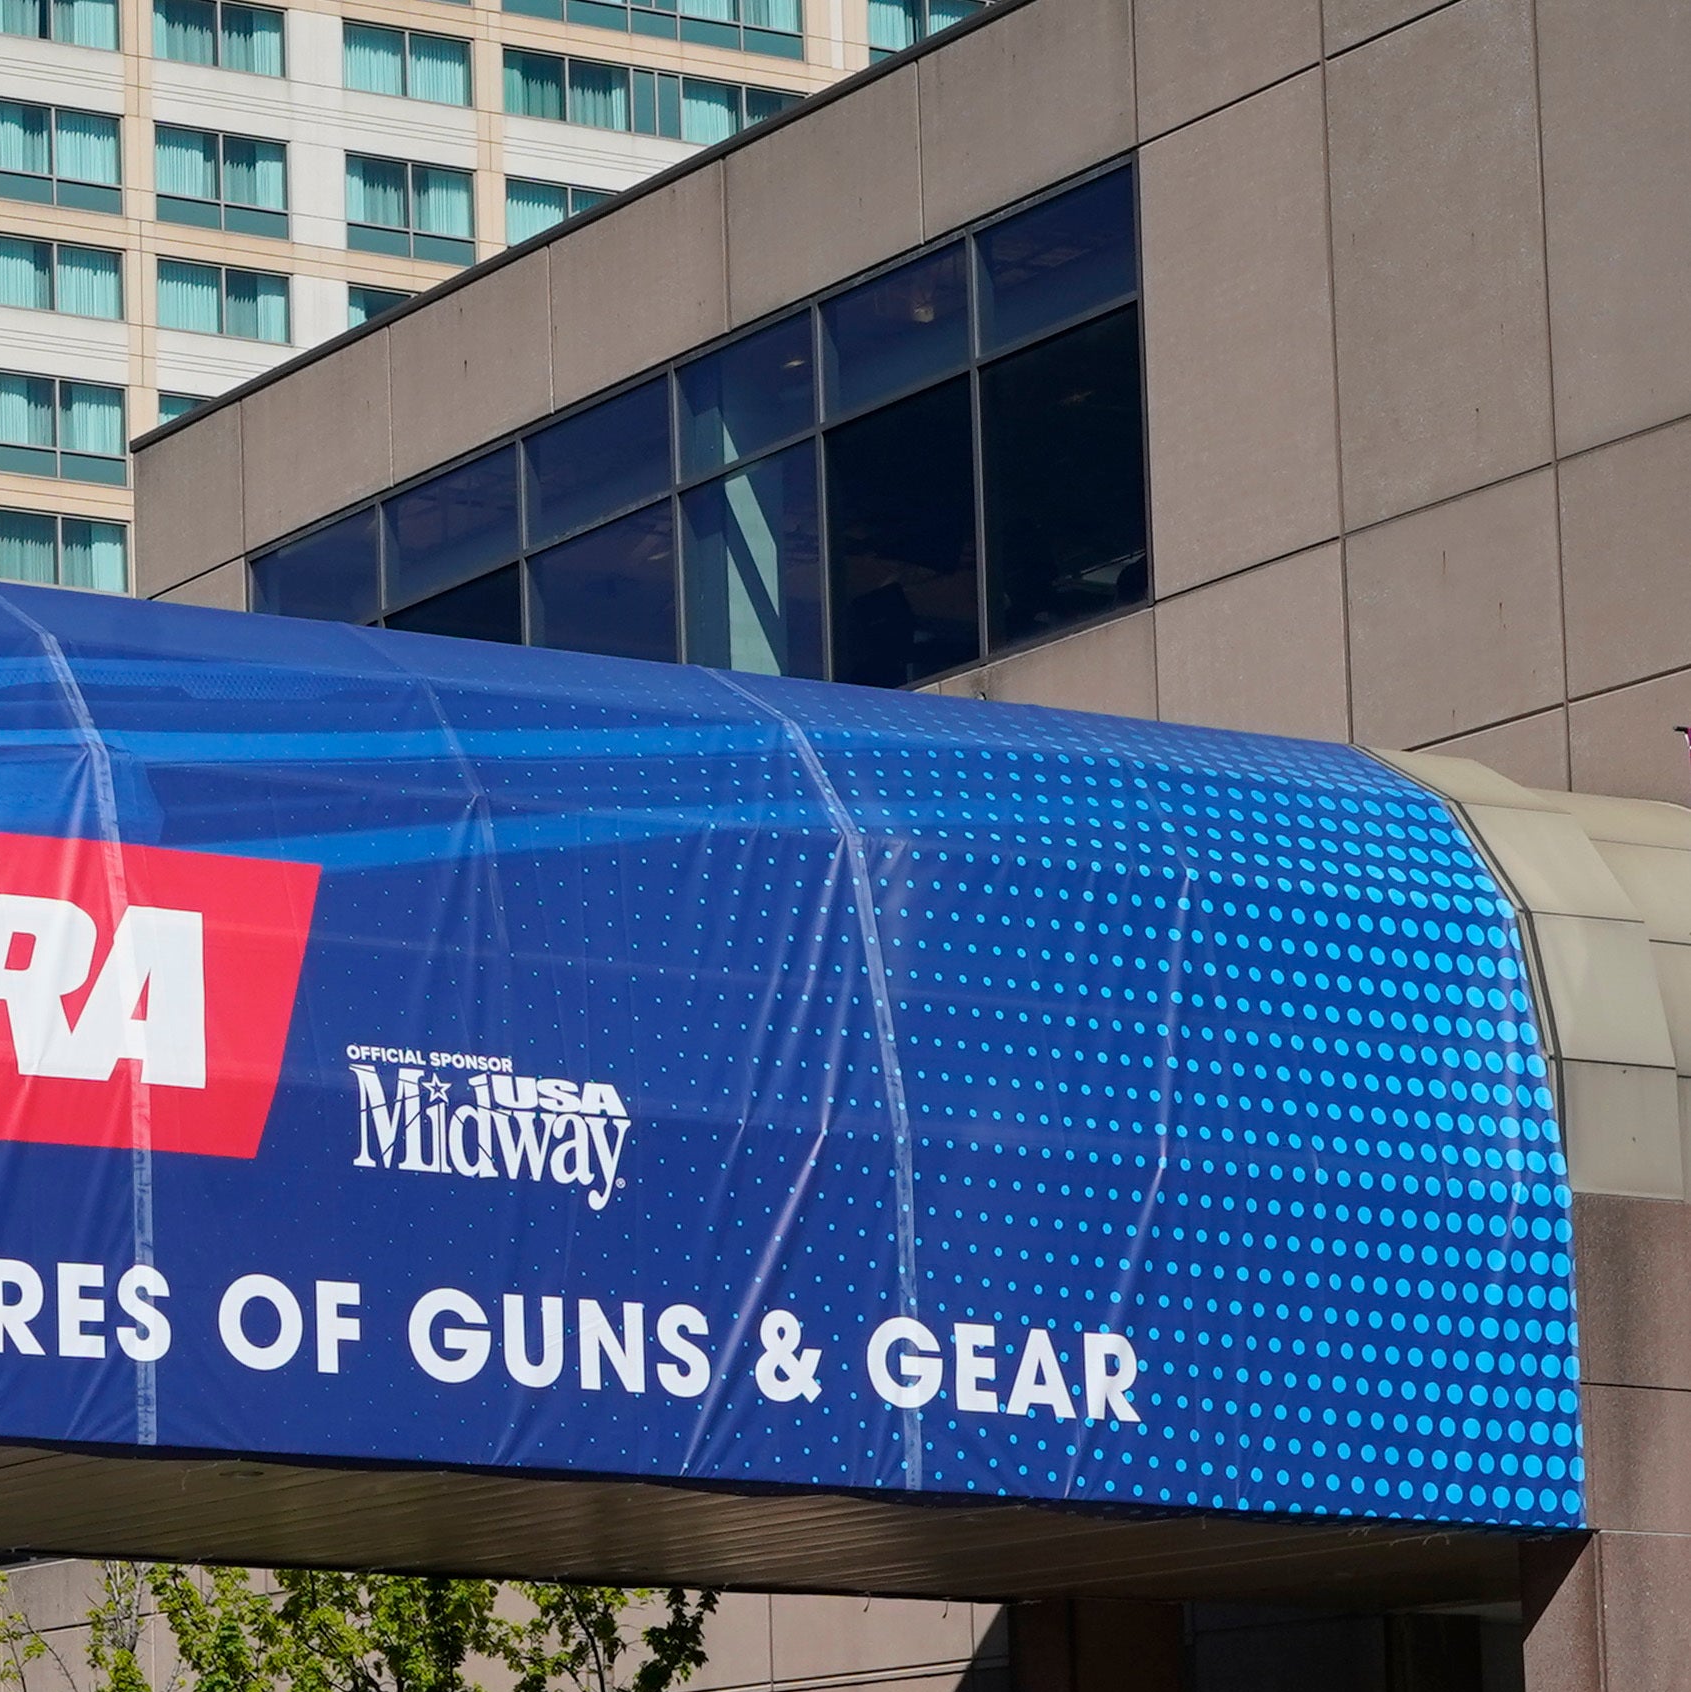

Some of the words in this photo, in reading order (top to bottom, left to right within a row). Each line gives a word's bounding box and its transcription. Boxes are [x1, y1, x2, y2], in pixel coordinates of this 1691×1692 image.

[346, 1044, 426, 1066] OFFICIAL
[429, 1051, 513, 1073] SPONSOR
[218, 1274, 363, 1375] OF
[408, 1287, 711, 1398] GUNS
[755, 1309, 822, 1404] &
[867, 1316, 1142, 1423] GEAR
